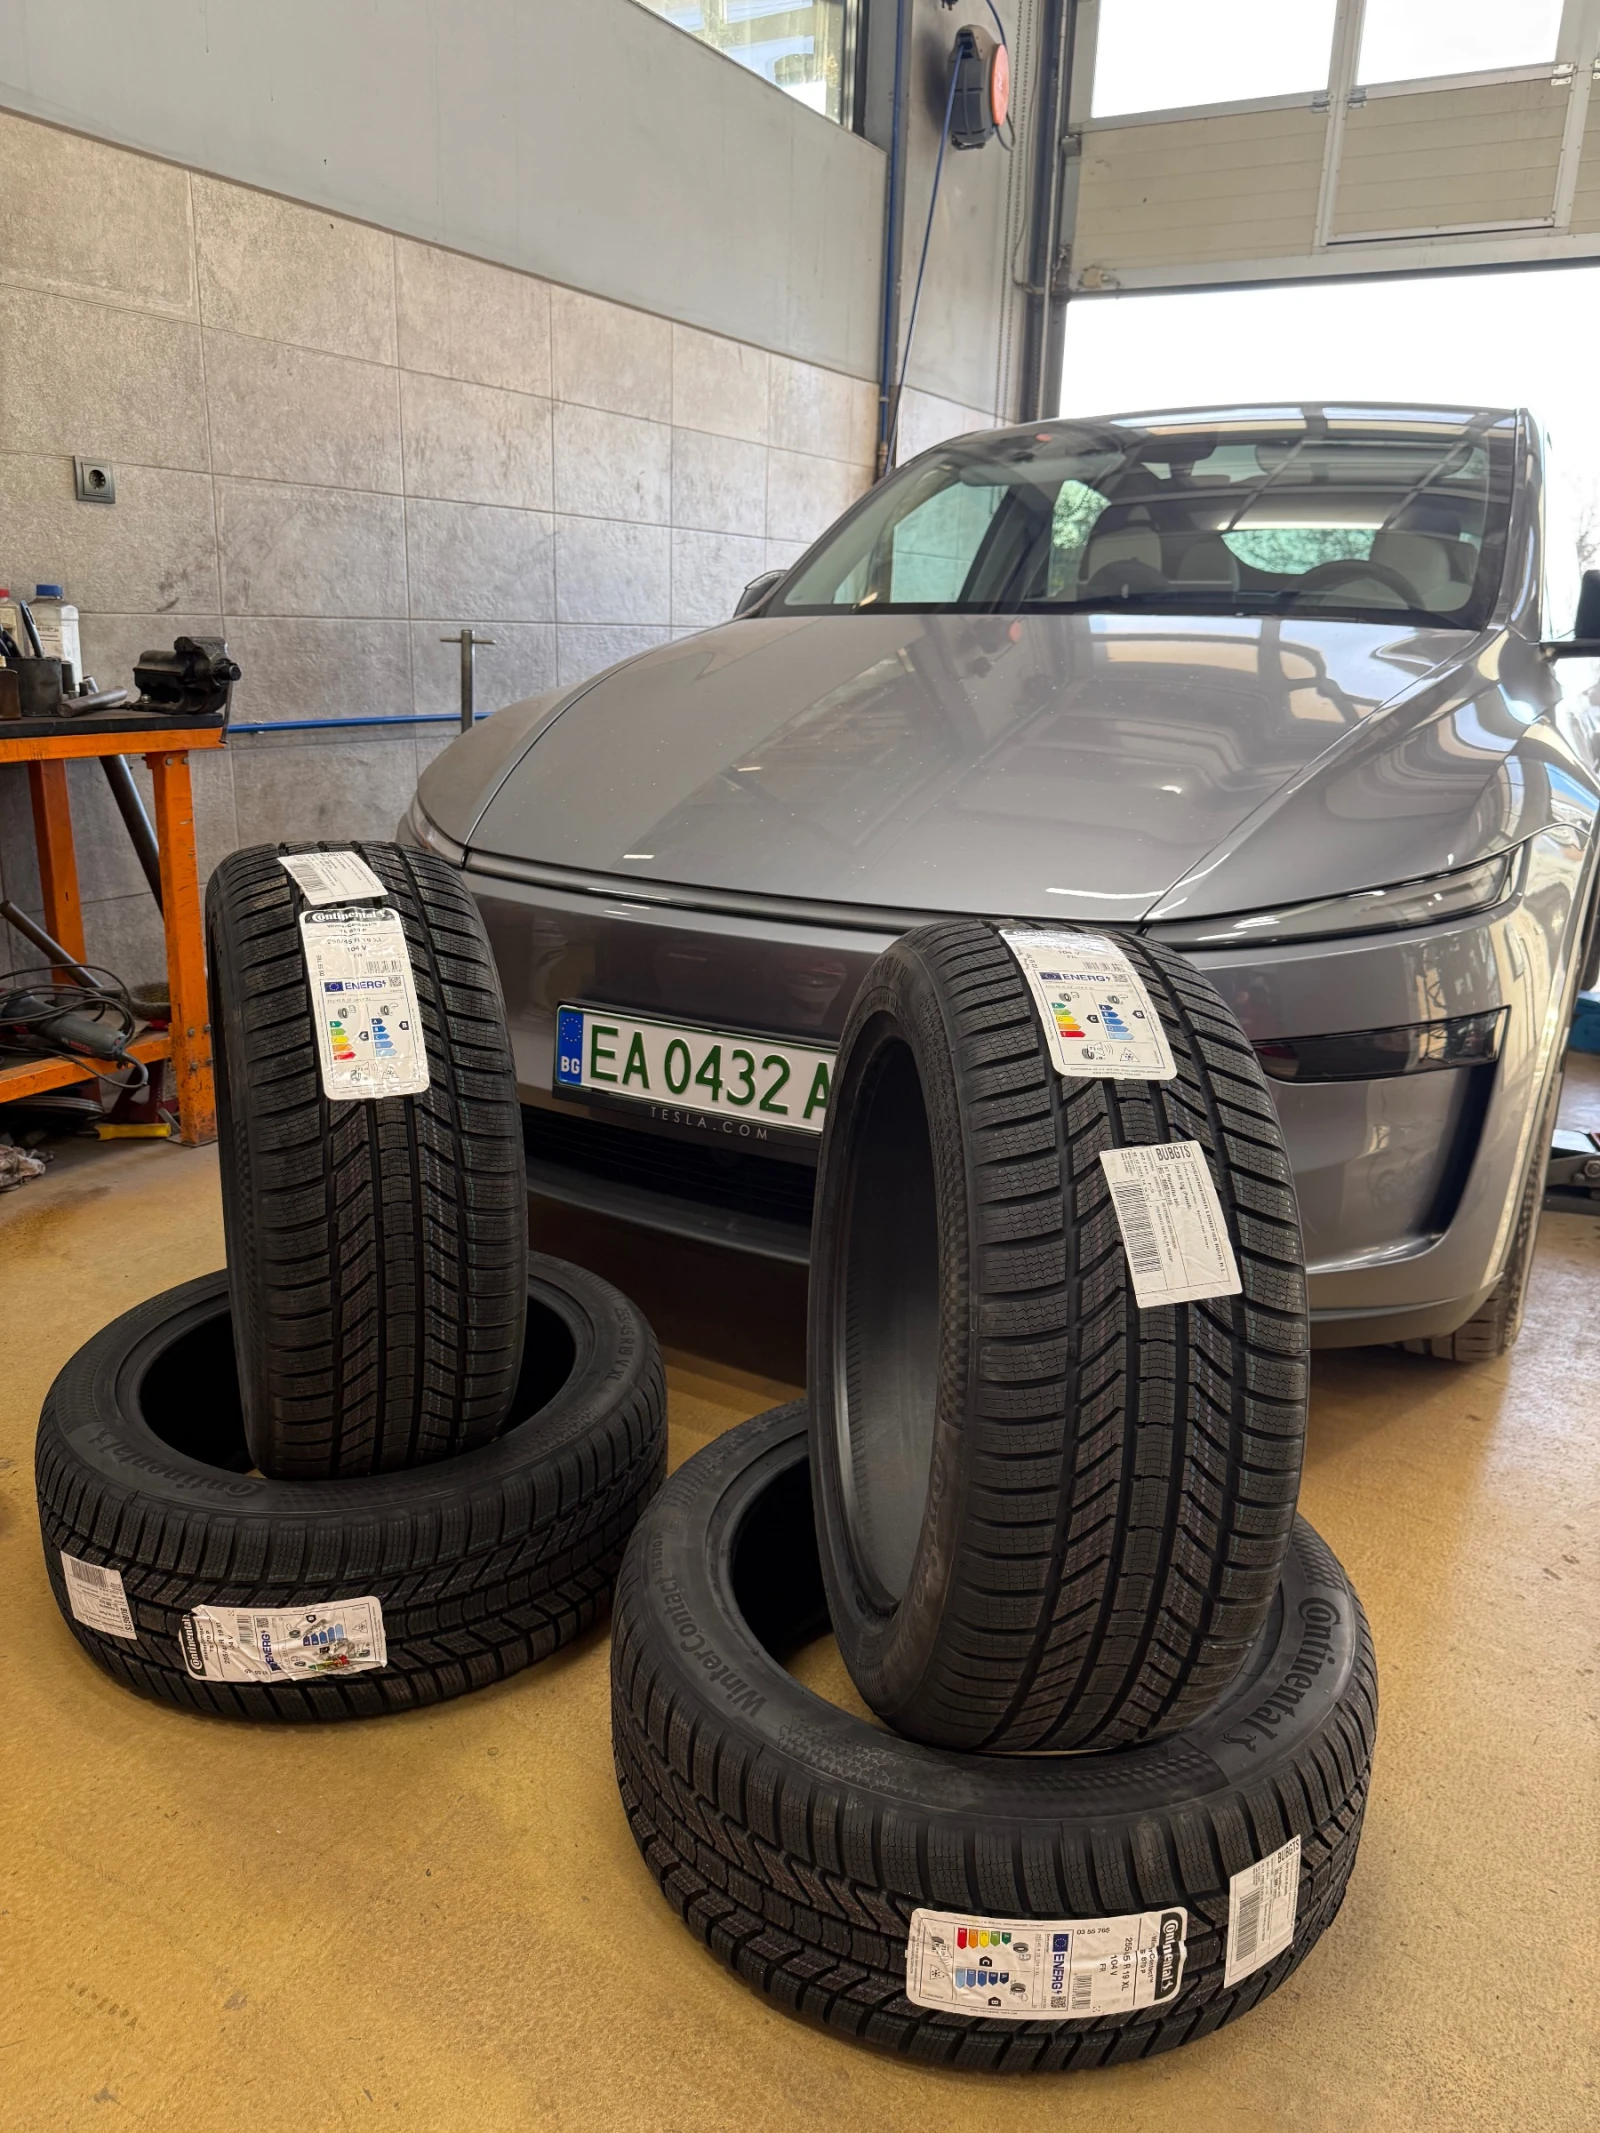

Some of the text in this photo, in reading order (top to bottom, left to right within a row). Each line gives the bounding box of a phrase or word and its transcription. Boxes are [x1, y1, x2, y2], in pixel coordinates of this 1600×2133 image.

[312, 910, 377, 922] Continental
[560, 1055, 581, 1075] BG
[590, 1023, 651, 1090] EA
[664, 1036, 792, 1116] 0432
[650, 1106, 769, 1141] TESLA.COM
[1155, 1145, 1191, 1161] BUBGTS
[182, 1614, 203, 1670] Continental
[655, 1576, 767, 1718] WinterContact
[1241, 1596, 1342, 1741] Continental
[1277, 1838, 1300, 1864] BUBGTS
[1099, 1963, 1107, 1972] FR
[1110, 1954, 1119, 1970] 104
[1121, 1980, 1130, 1991] XL
[1122, 1971, 1131, 1981] 19
